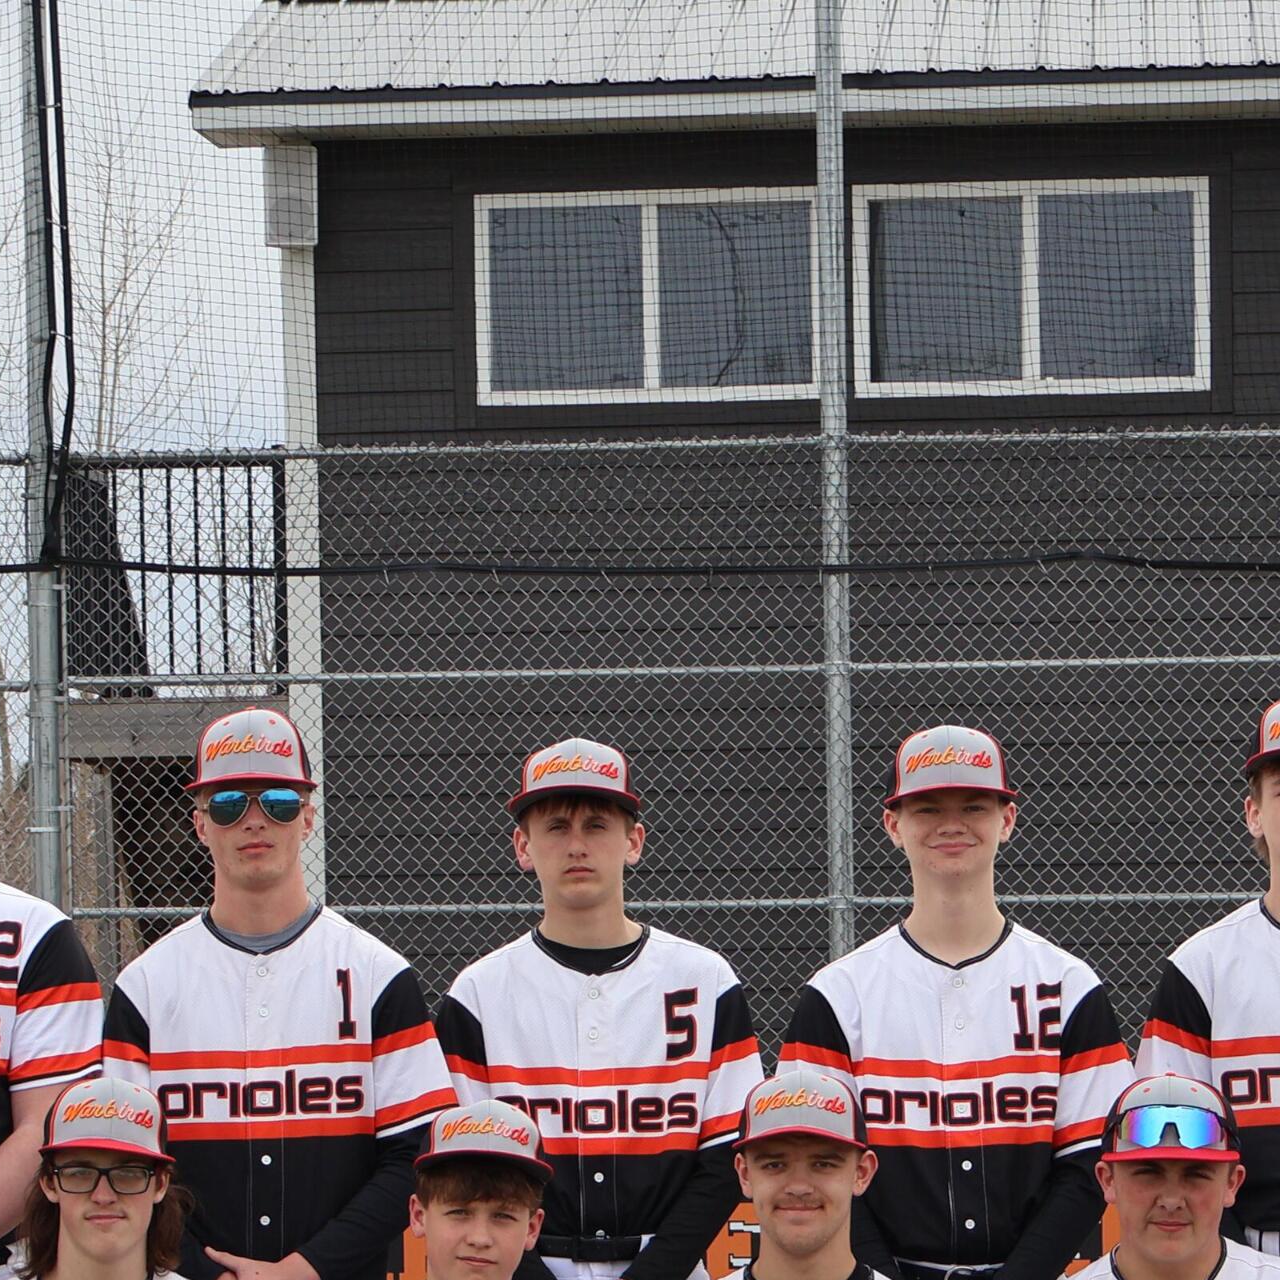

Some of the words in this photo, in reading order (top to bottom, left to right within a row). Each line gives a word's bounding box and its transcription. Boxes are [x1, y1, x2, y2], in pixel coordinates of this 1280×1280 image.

[205, 734, 293, 761] Warbirds
[905, 747, 992, 771] Warbirds
[531, 752, 619, 781] Warbirds
[336, 969, 356, 1039] 1
[1009, 982, 1062, 1051] 12
[664, 987, 698, 1060] 5
[158, 1070, 365, 1118] orioles
[753, 1090, 848, 1117] Warbirds
[859, 1082, 1059, 1126] orioles
[63, 1100, 154, 1128] Warbirds
[442, 1117, 530, 1145] Warbirds
